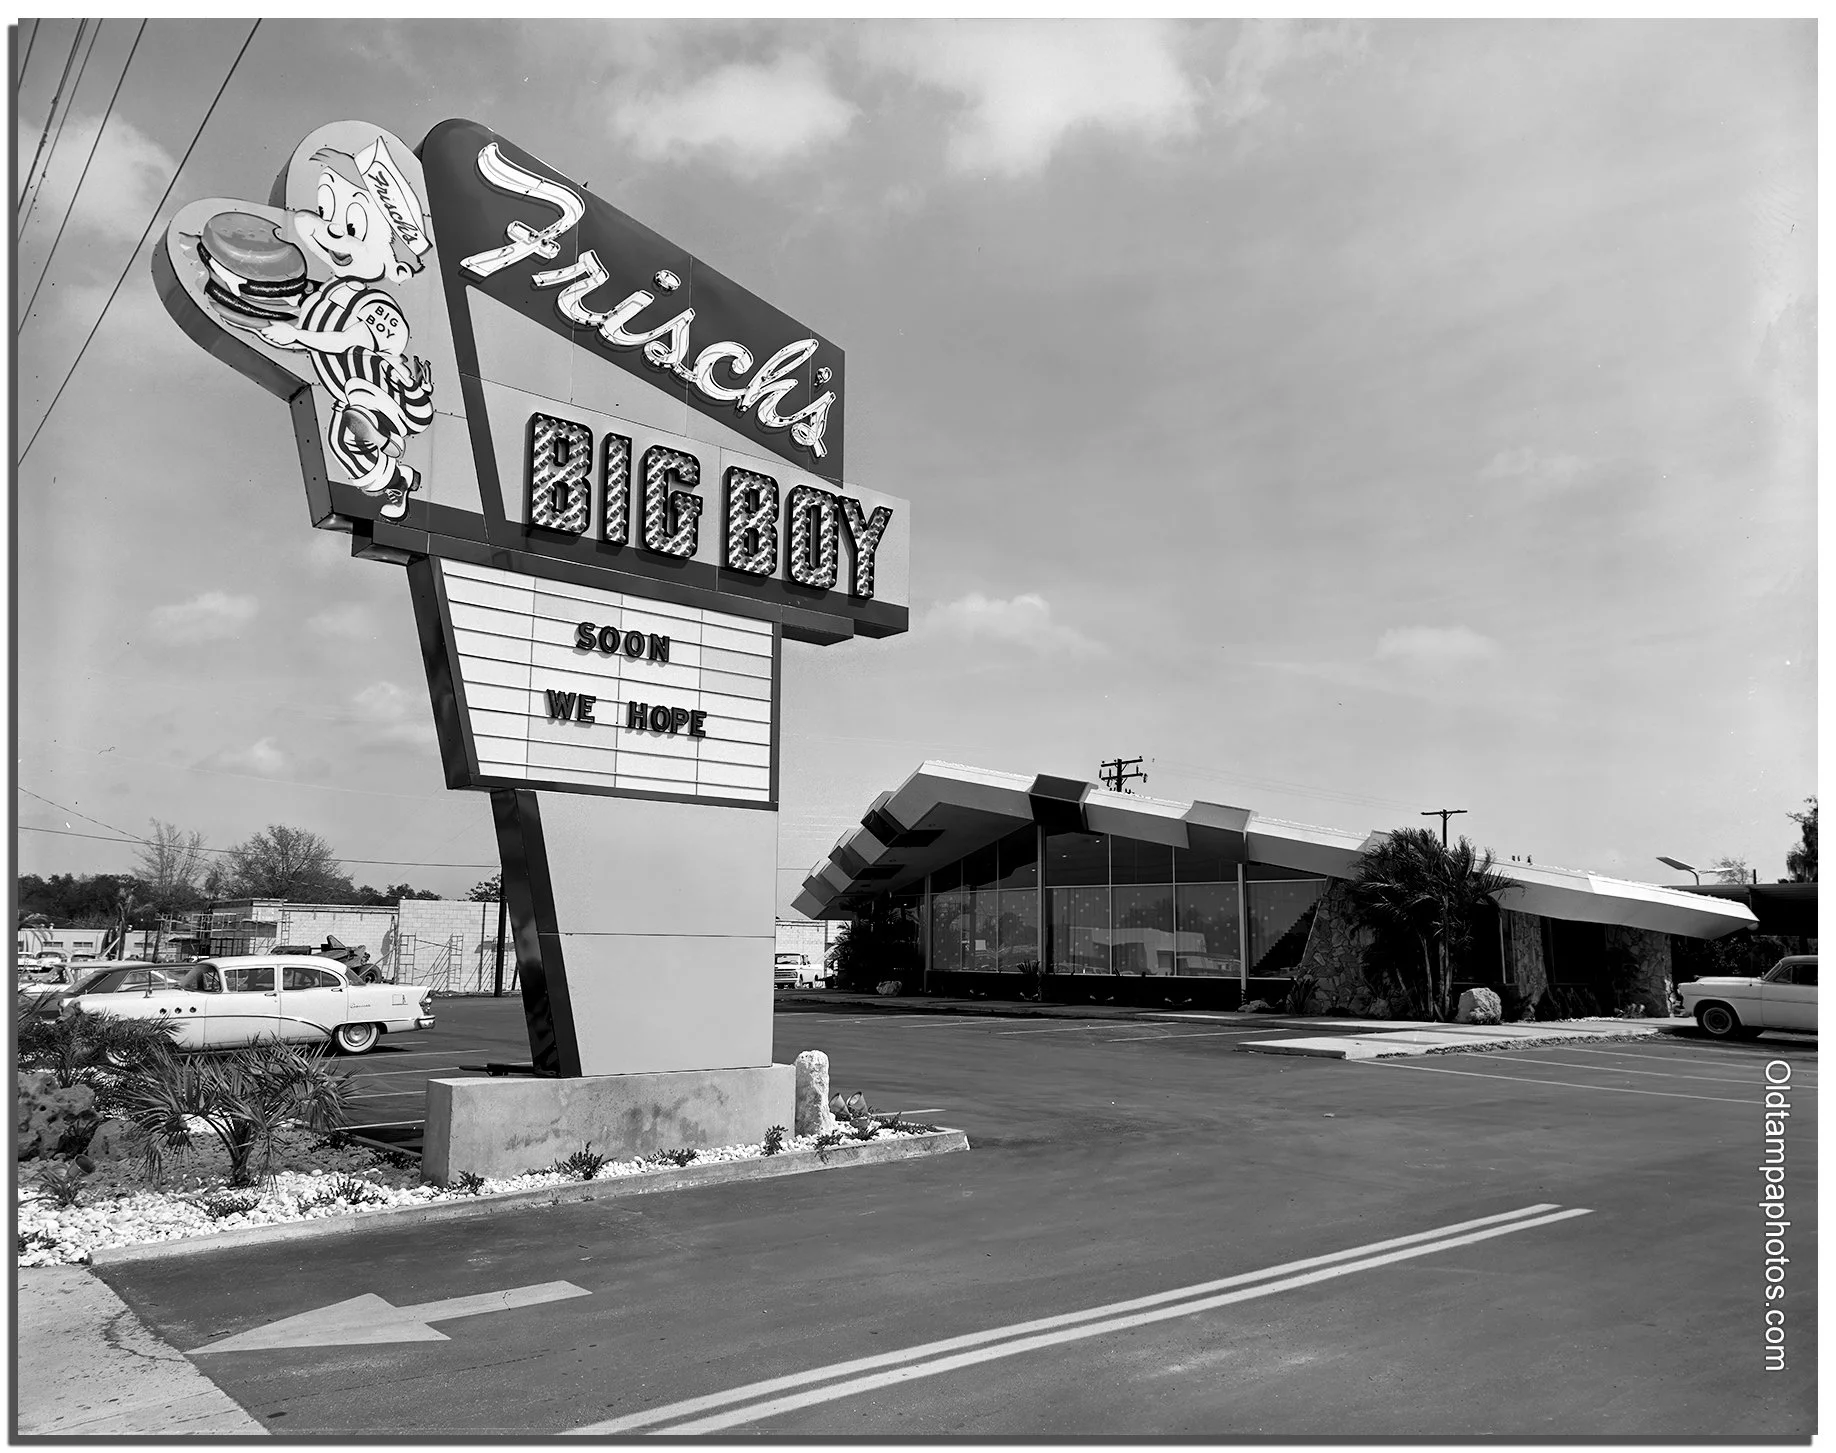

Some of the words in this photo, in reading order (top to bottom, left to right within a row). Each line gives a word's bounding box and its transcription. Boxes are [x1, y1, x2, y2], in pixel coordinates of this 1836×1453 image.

[367, 170, 419, 245] Frisch's
[374, 305, 399, 328] BIG
[459, 142, 837, 459] Frisch's
[365, 314, 396, 339] BOY
[526, 411, 704, 560] BIG
[721, 465, 894, 600] BOY
[575, 621, 671, 663] SOON
[545, 688, 597, 724] WE
[626, 700, 708, 738] HOPE
